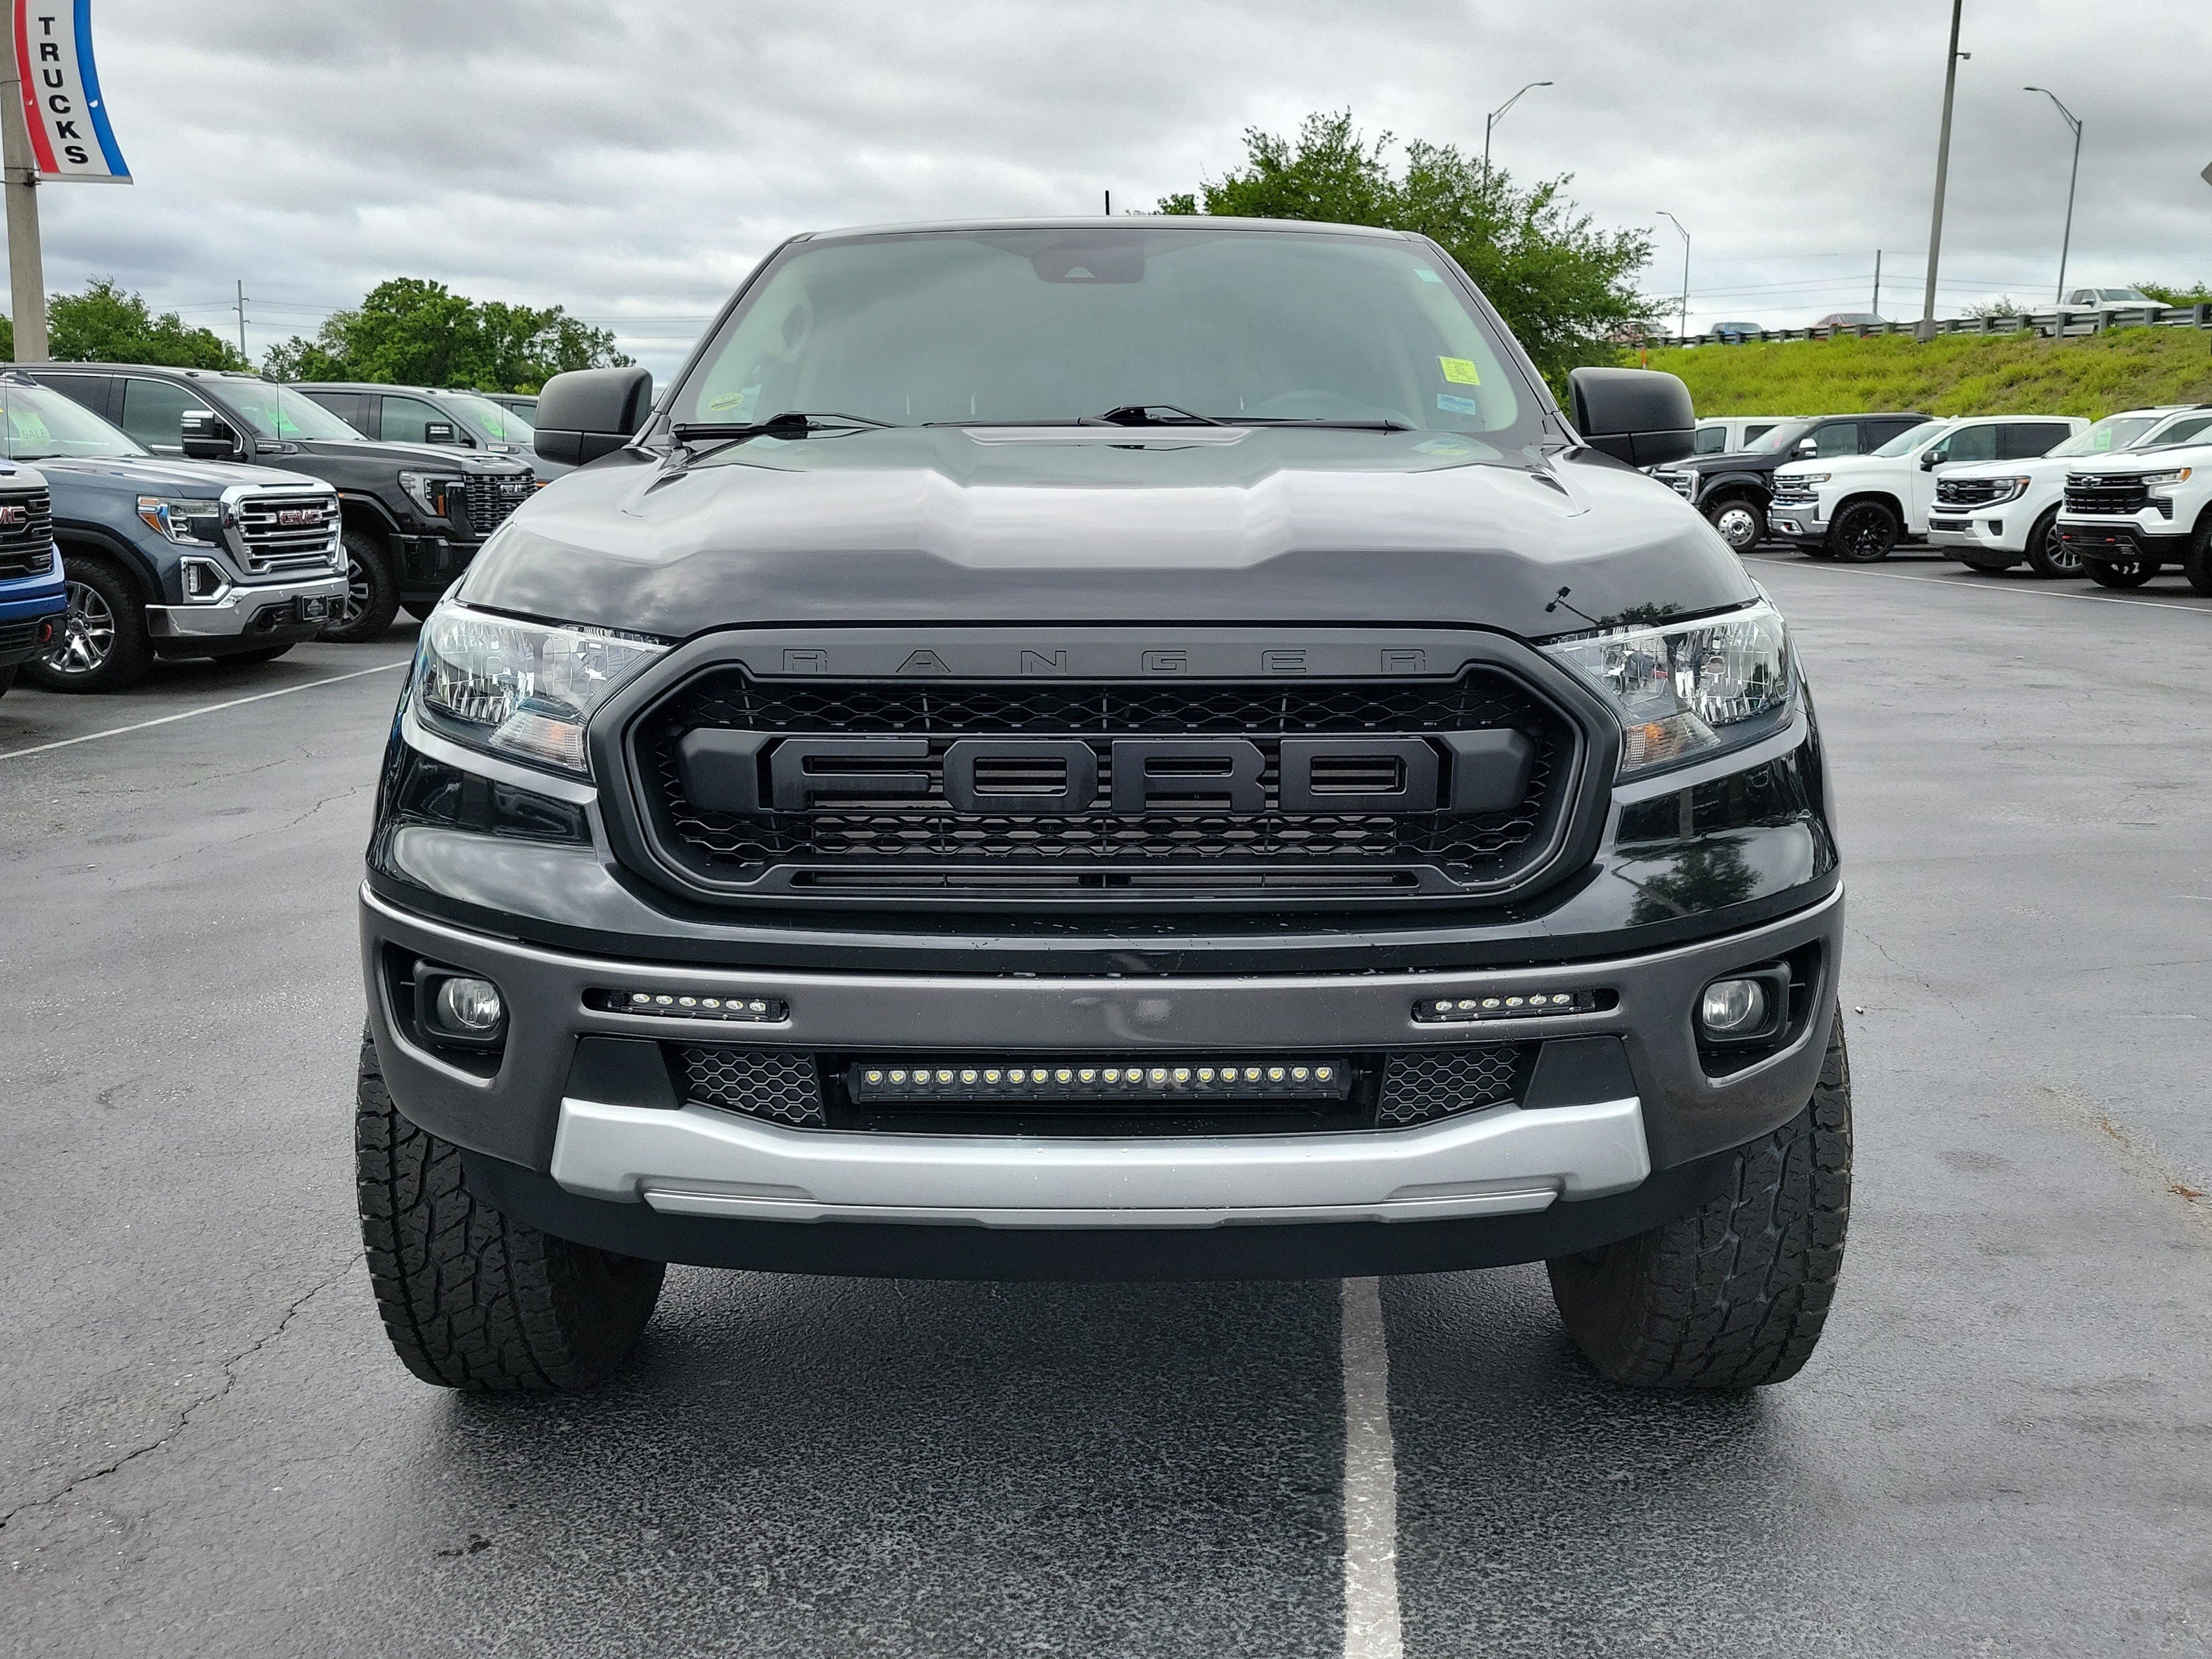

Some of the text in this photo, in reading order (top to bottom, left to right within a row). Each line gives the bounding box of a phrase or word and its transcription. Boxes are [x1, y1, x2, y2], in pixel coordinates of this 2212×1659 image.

[38, 16, 89, 164] TRUCKS
[22, 430, 48, 439] SALE
[279, 509, 323, 525] GMC
[782, 648, 1425, 673] RANGER
[770, 738, 1439, 812] FORD
